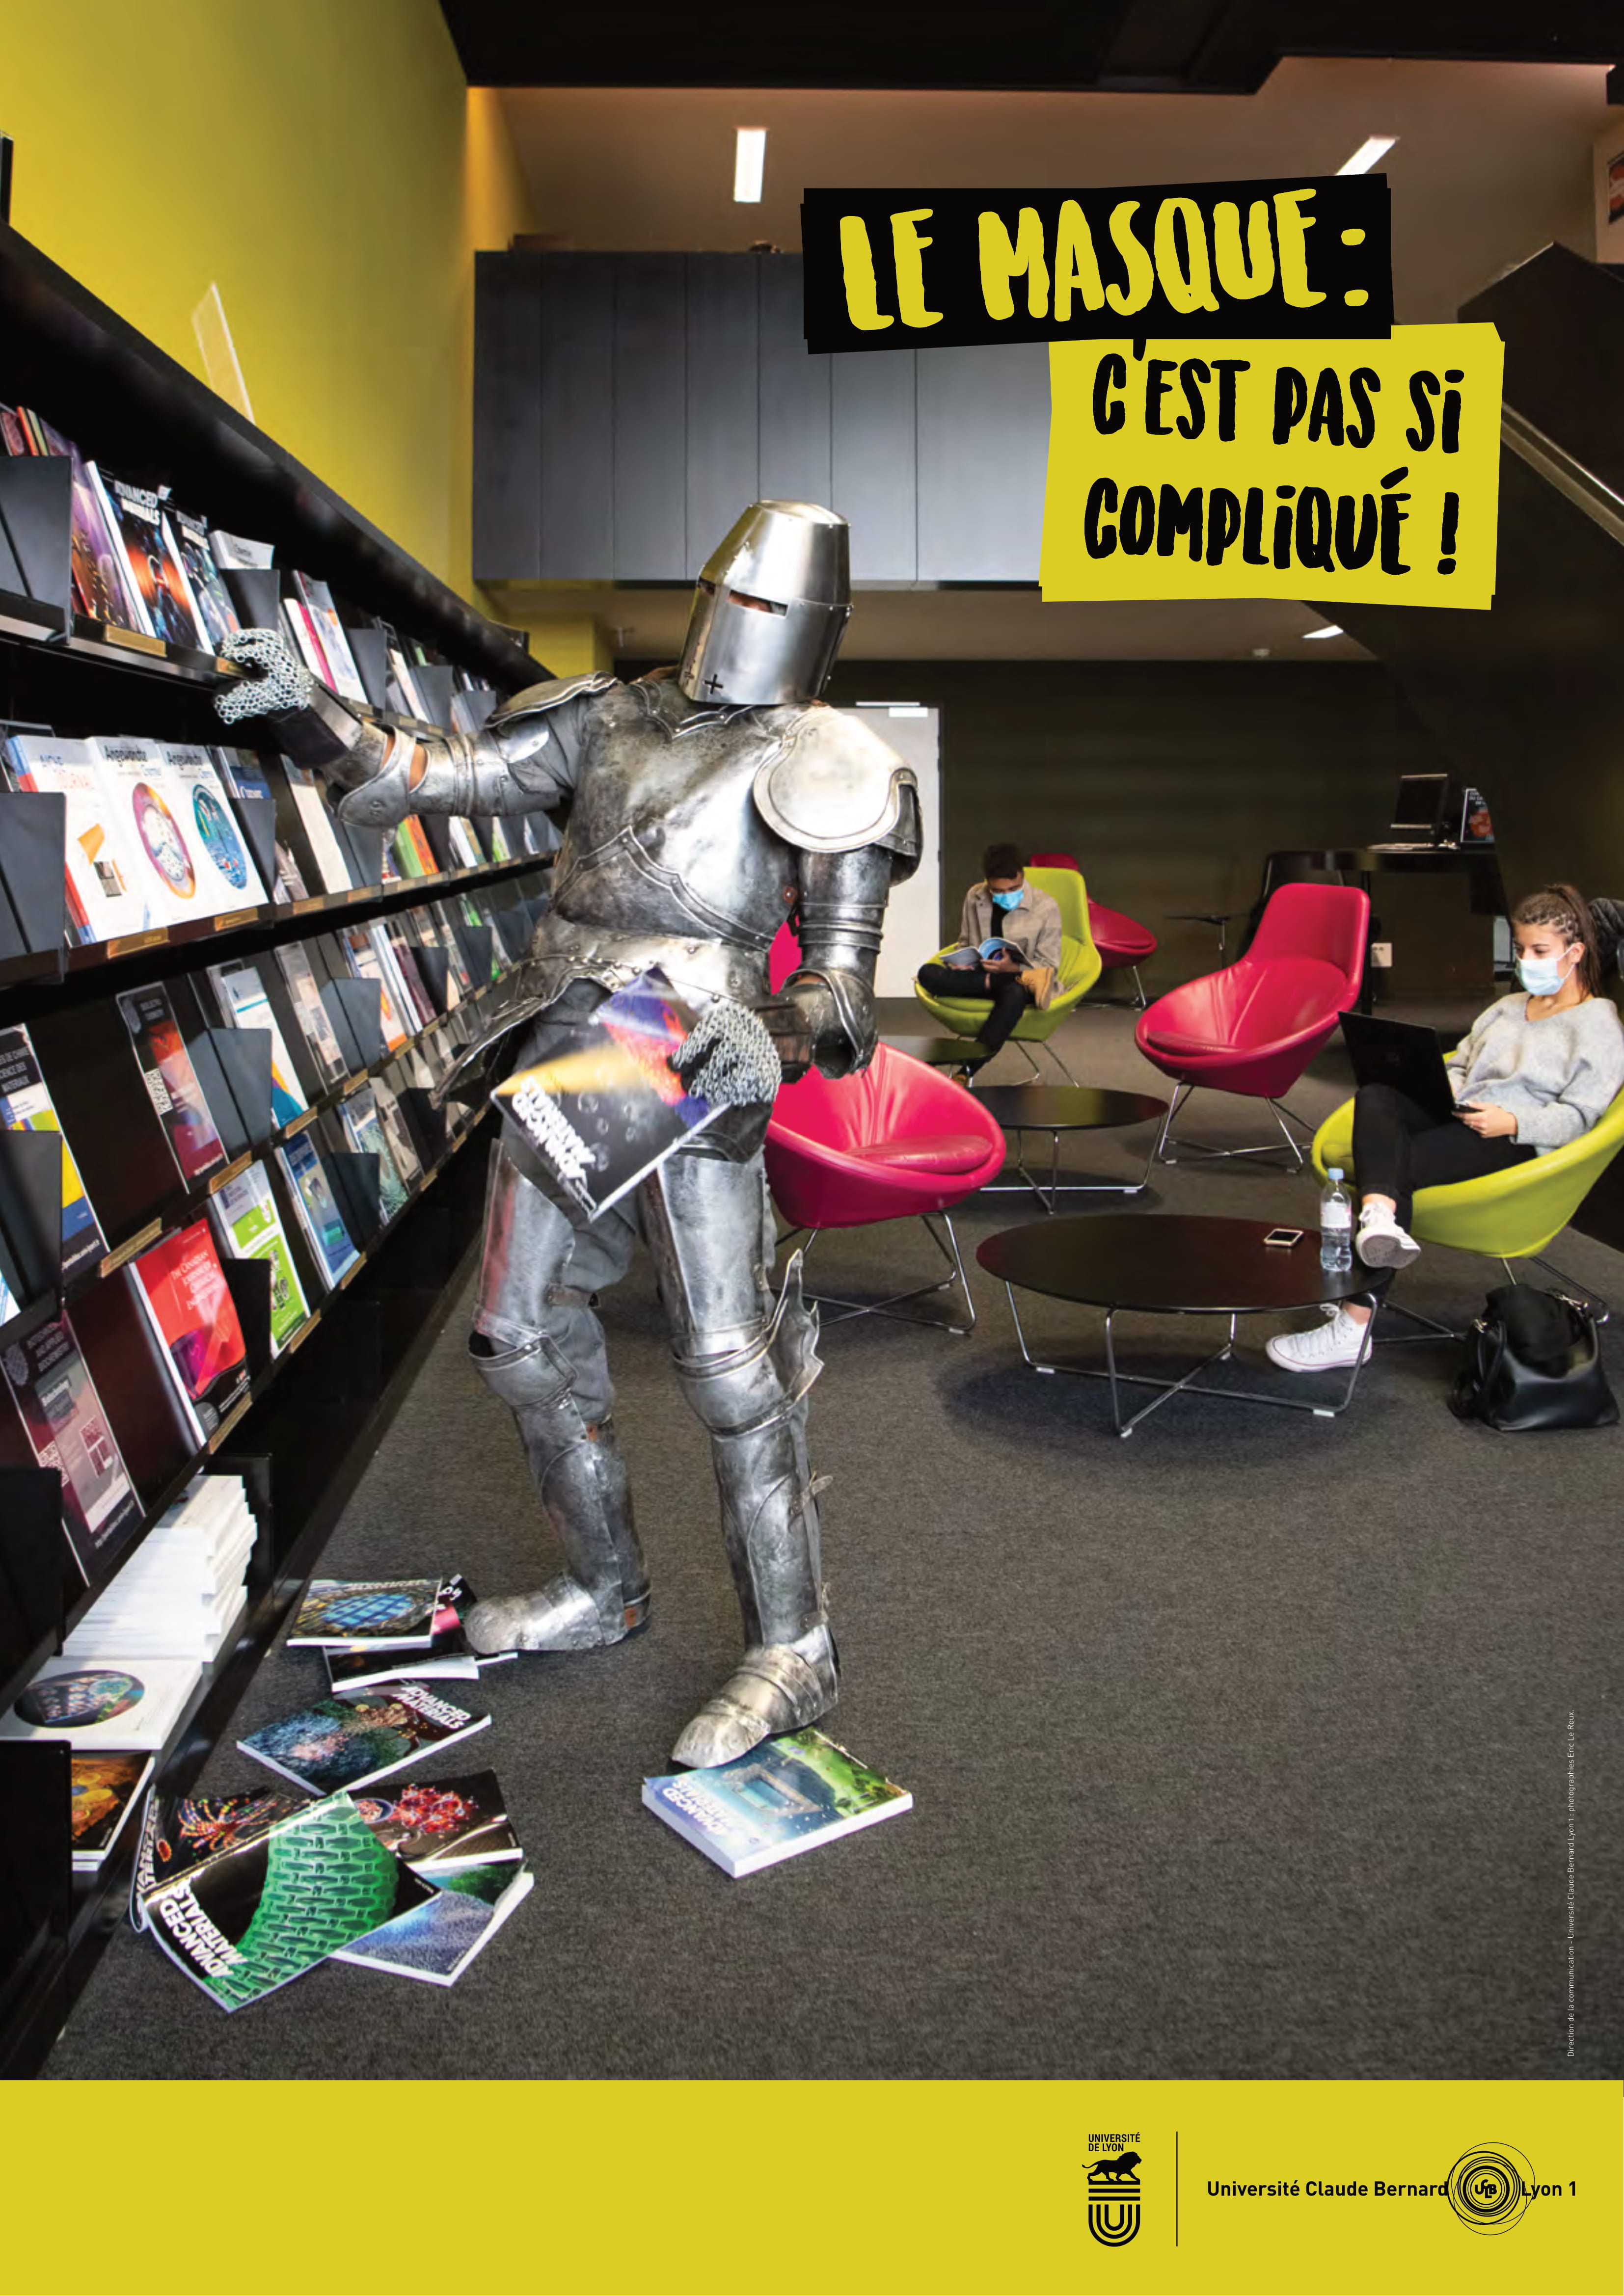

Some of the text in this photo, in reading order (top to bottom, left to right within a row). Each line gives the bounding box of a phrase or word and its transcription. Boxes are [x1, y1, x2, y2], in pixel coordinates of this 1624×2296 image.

[392, 1693, 464, 1729] MATERIALS
[401, 1686, 472, 1721] ADVANCED
[160, 1897, 233, 1977] ADVANCED
[173, 1877, 248, 1964] MATERIALS
